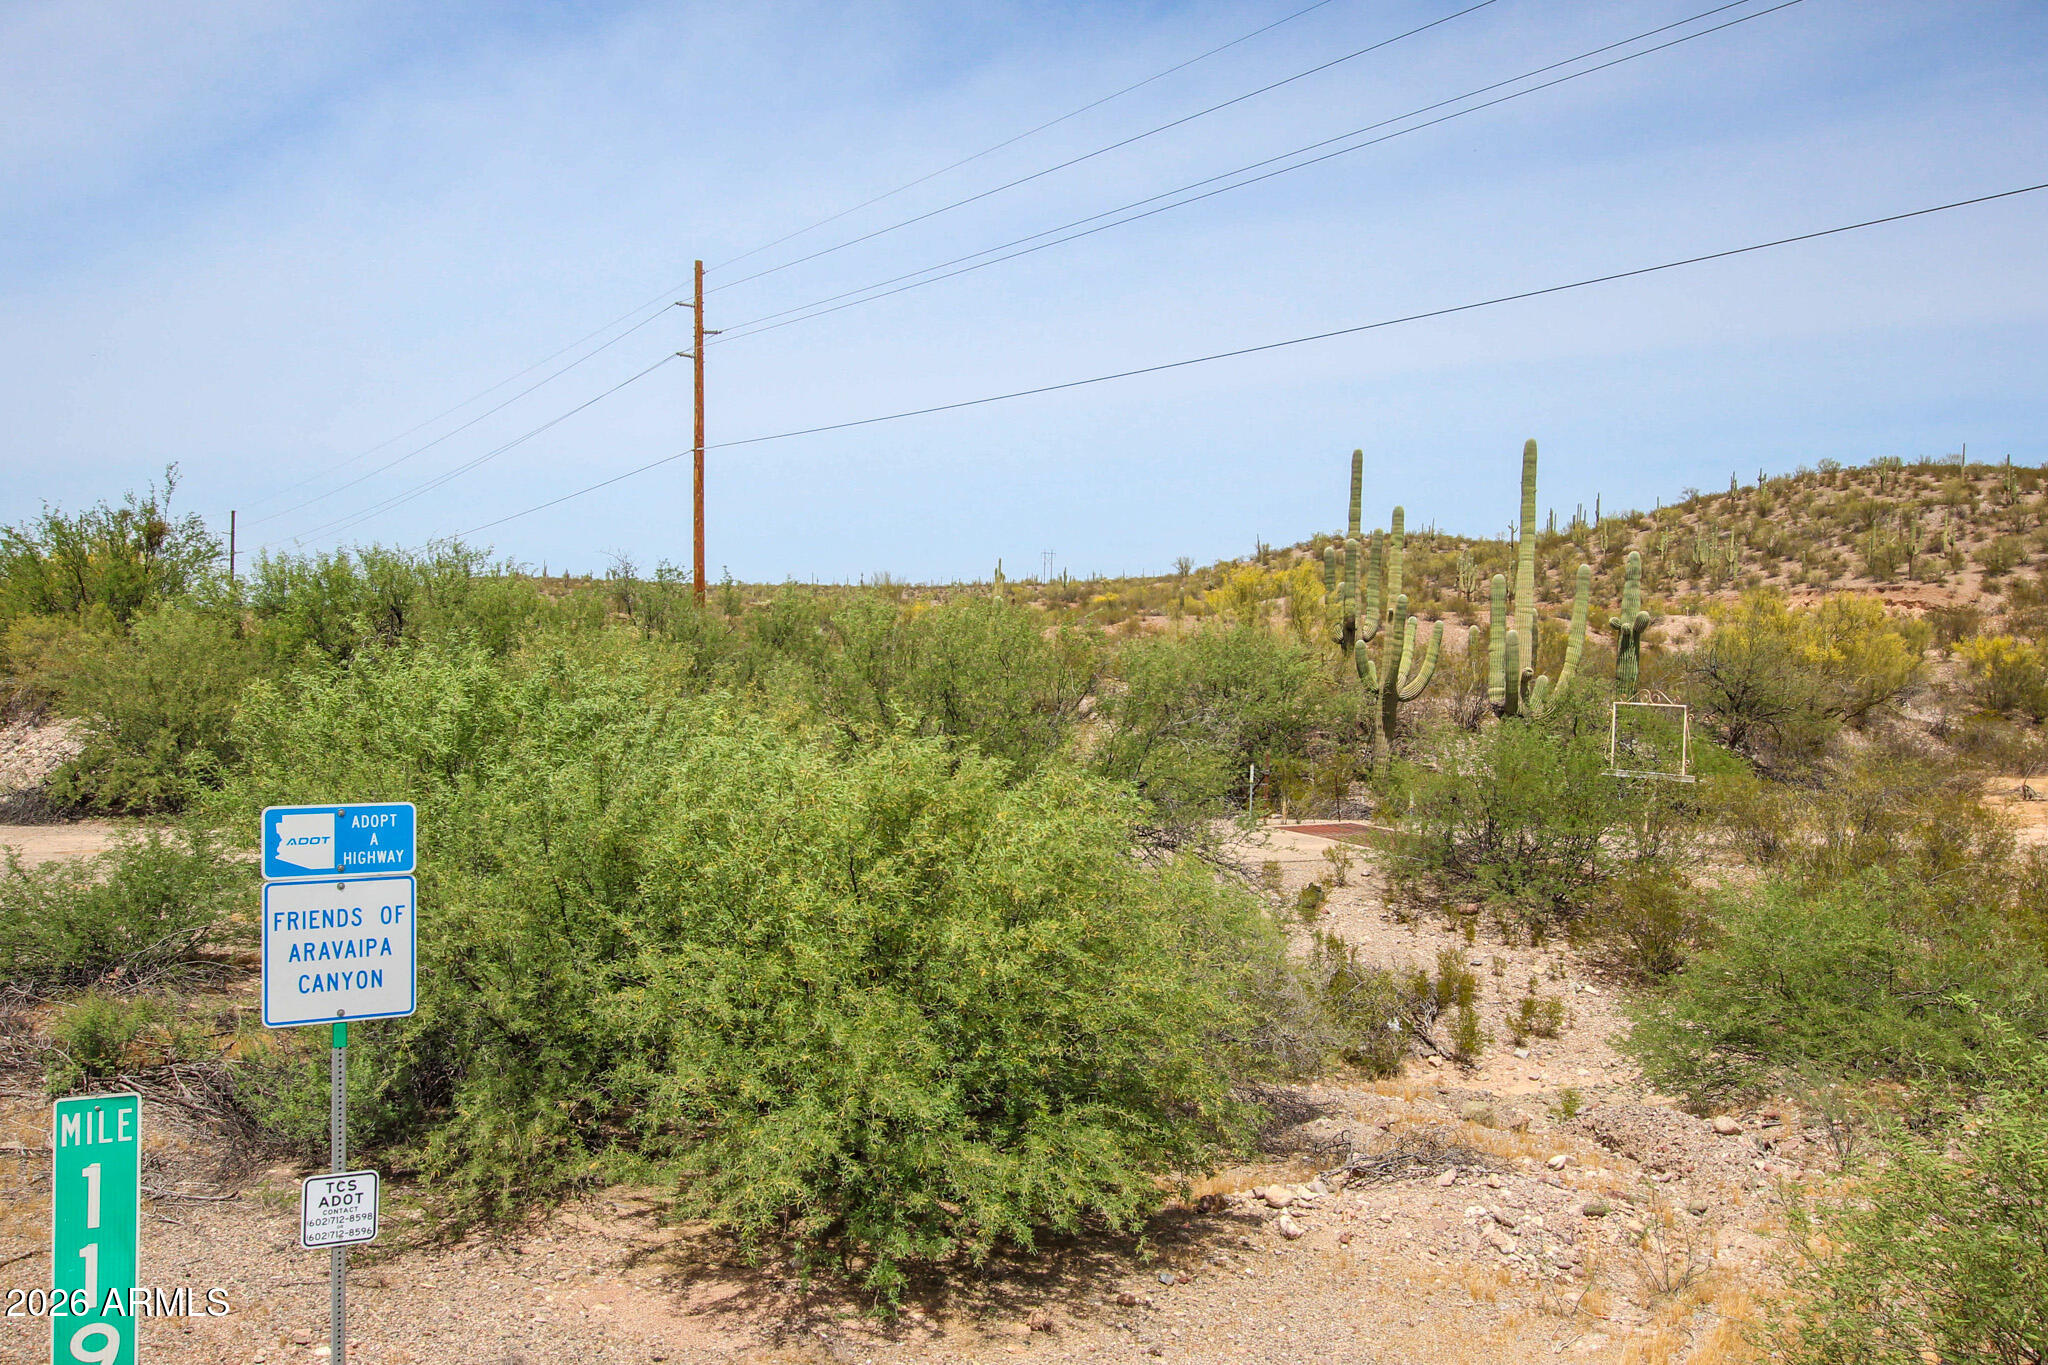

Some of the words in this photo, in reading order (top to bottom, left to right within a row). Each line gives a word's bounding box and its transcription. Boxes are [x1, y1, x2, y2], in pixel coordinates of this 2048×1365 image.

[352, 814, 397, 829] ADOPT
[286, 836, 331, 846] ADOT
[370, 833, 378, 845] A
[343, 850, 404, 865] HIGHWAY
[274, 907, 362, 932] FRIENDS
[380, 905, 405, 925] OF
[288, 937, 392, 963] ARAVAIPA
[299, 969, 383, 994] CANYON
[61, 1108, 133, 1147] MILE
[326, 1180, 357, 1194] TCS
[318, 1192, 364, 1208] ADOT
[322, 1206, 358, 1216] CONTACT
